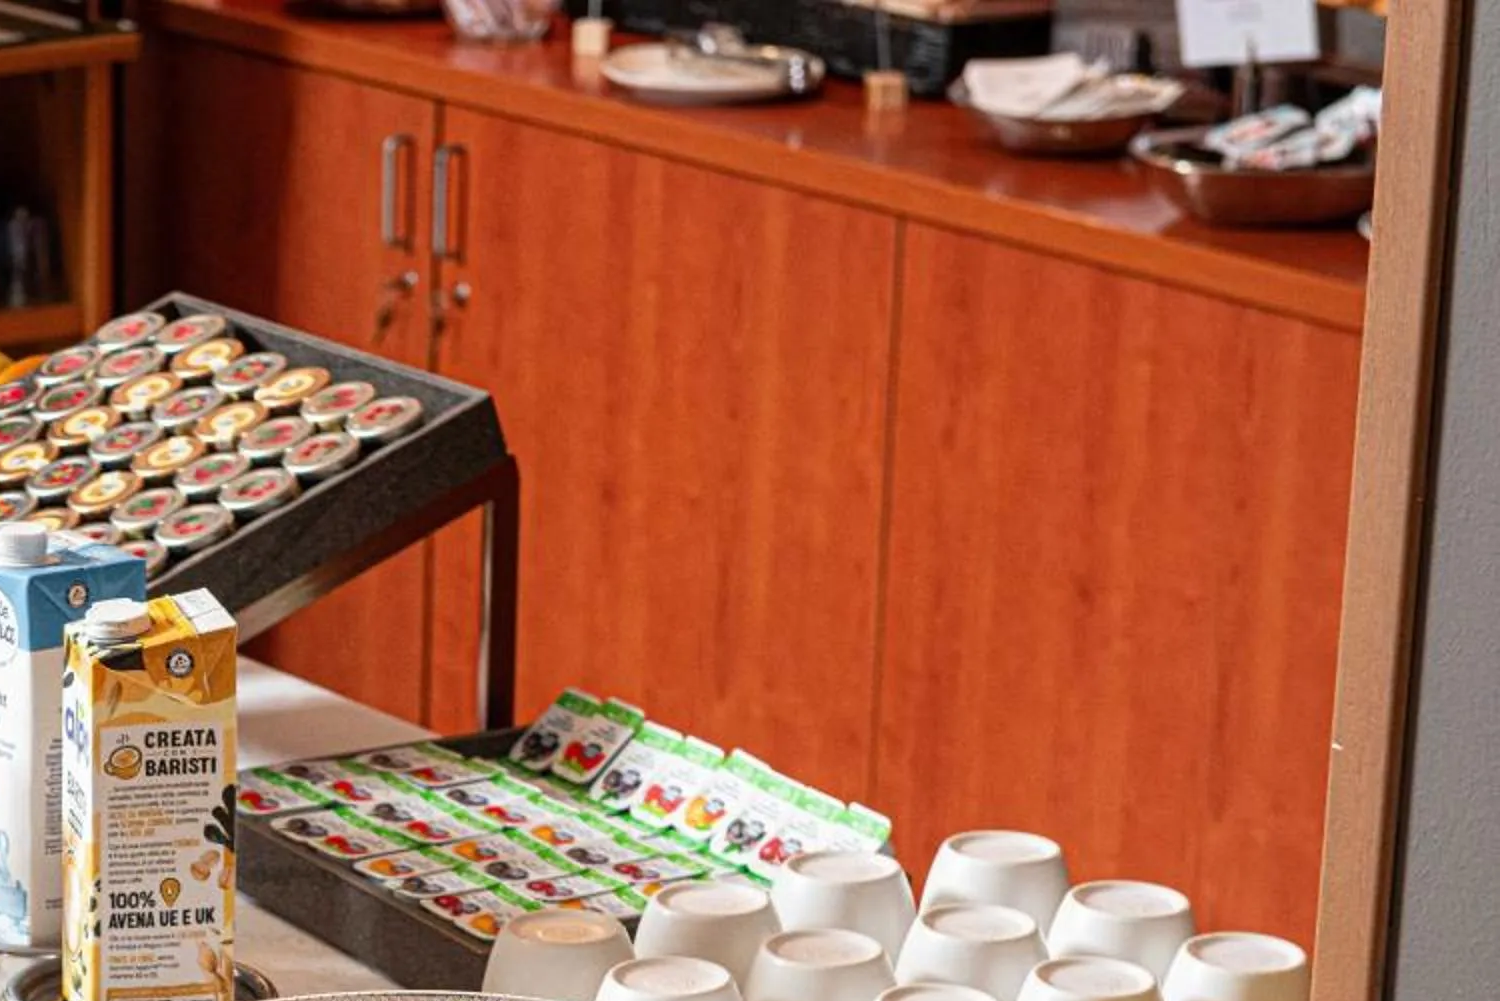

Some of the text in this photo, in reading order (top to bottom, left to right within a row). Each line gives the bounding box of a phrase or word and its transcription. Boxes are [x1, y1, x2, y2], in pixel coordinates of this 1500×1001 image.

[144, 728, 217, 748] CREATA
[145, 757, 217, 777] BARISTI
[108, 890, 157, 909] 100%
[108, 906, 216, 930] AVENA UE E UK
